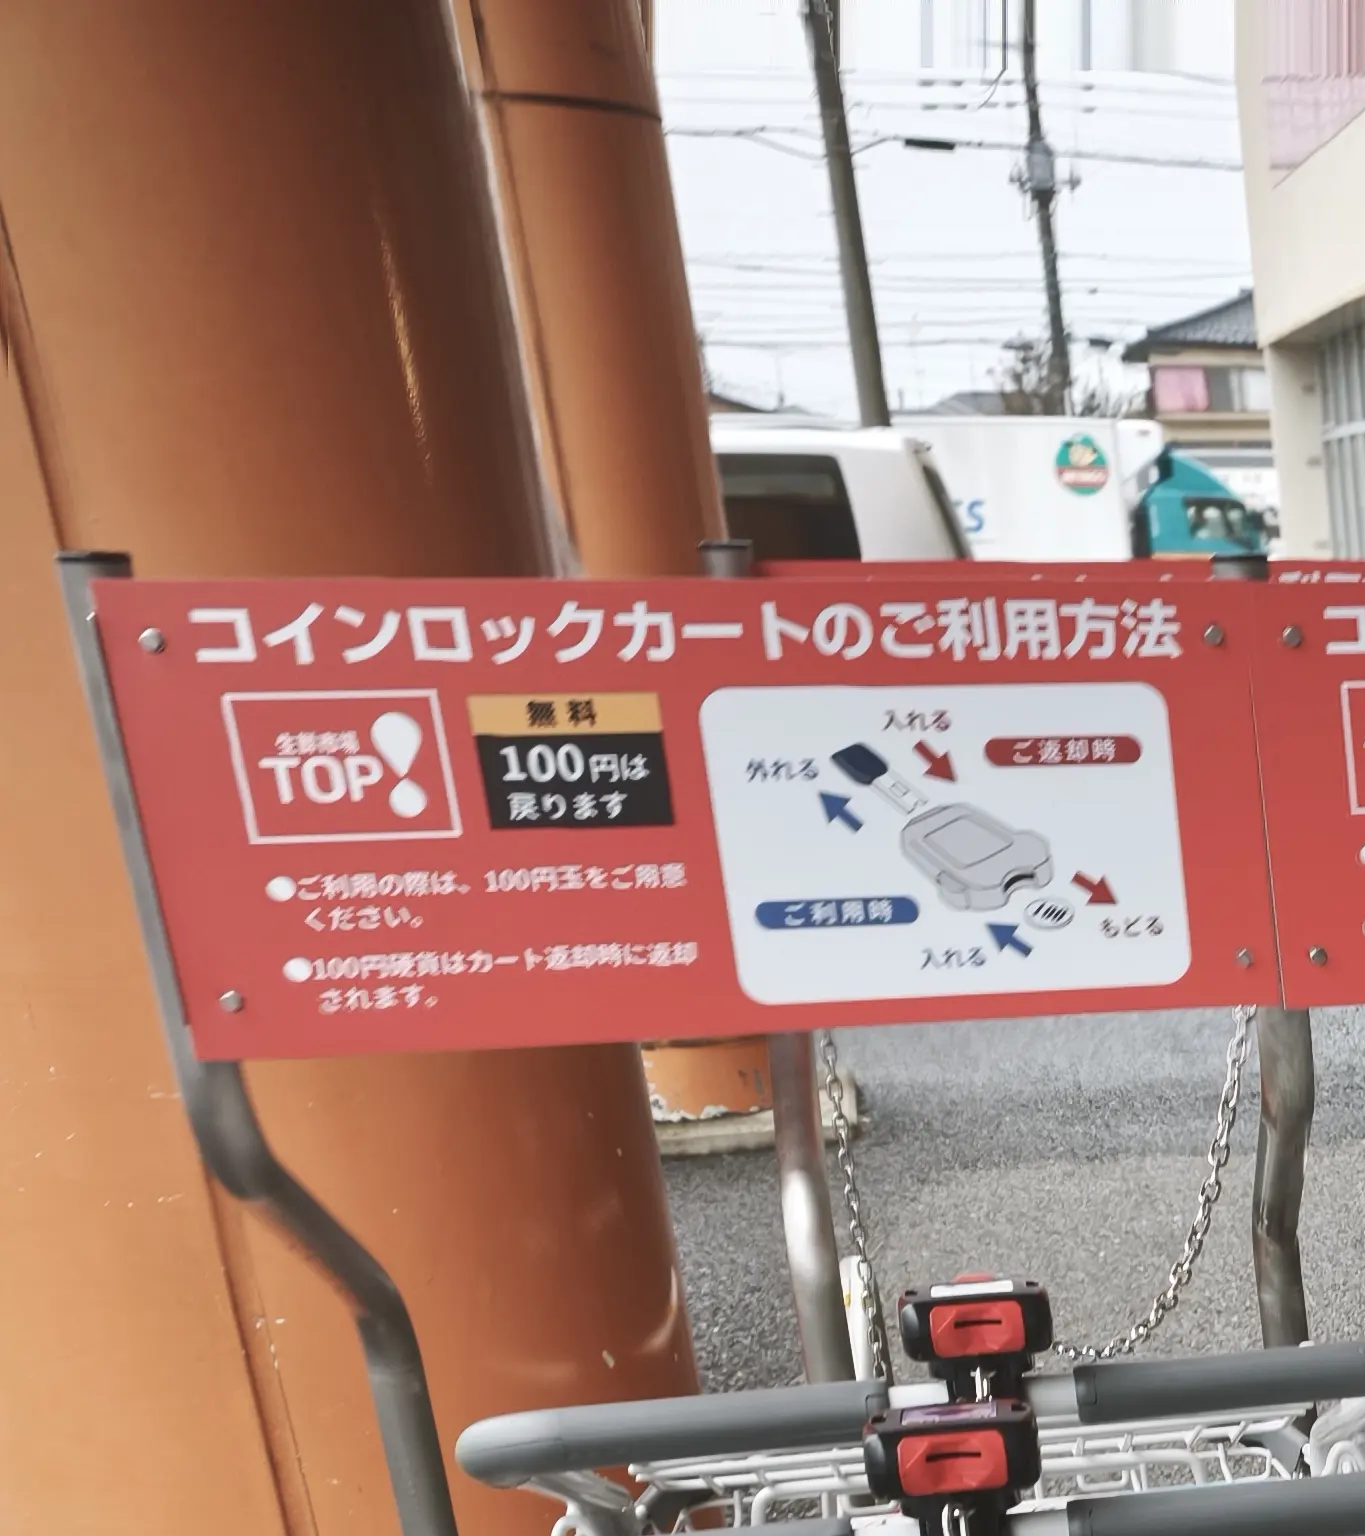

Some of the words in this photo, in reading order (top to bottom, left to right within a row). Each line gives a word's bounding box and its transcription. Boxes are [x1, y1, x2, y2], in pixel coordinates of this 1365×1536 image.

[188, 597, 1183, 664] コインロックカートのご利用方法
[526, 699, 596, 728] 無料
[882, 709, 952, 733] 入れる
[499, 743, 650, 783] 100円は
[1012, 736, 1118, 764] ご返却時
[745, 758, 820, 784] 外れる
[507, 791, 628, 821] 戻ります
[304, 906, 424, 932] ください。
[783, 899, 895, 927] ご利用時
[1101, 916, 1165, 939] もどる
[920, 948, 986, 971] 入れる
[317, 984, 439, 1015] されます。
